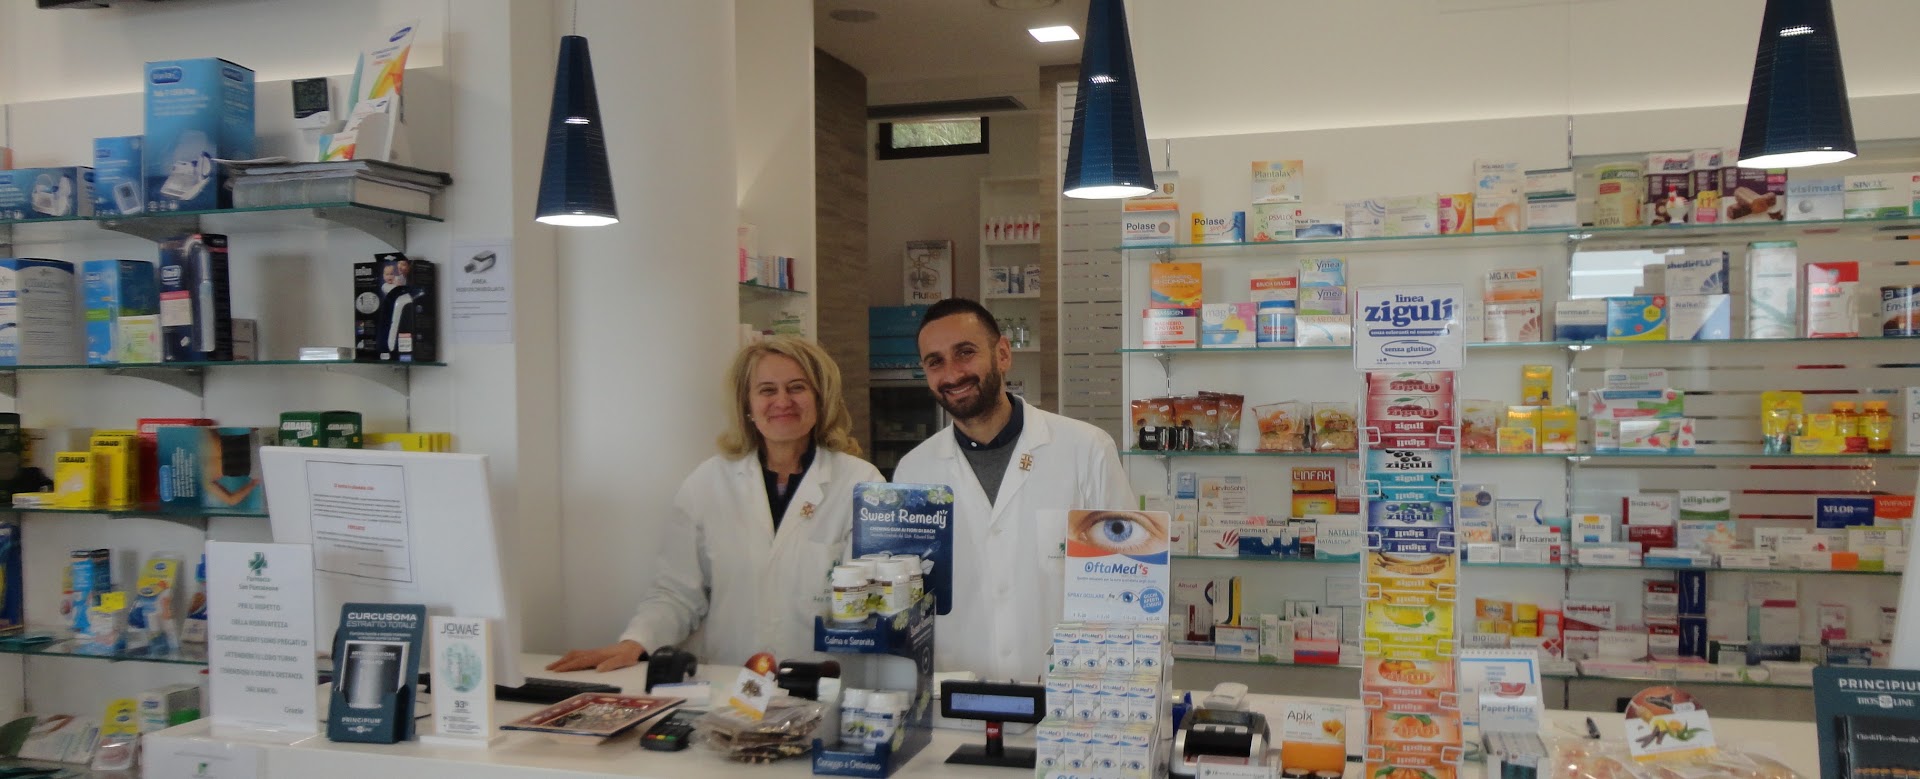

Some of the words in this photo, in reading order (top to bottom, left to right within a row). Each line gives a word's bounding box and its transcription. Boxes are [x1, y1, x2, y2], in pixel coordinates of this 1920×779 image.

[1126, 222, 1156, 232] Polase
[1194, 217, 1225, 227] Polase
[1395, 294, 1424, 303] linea
[1406, 344, 1433, 353] glutine
[282, 421, 313, 431] GIBAUD
[1292, 470, 1333, 482] LINFAX
[860, 507, 896, 522] Sweet
[898, 508, 949, 529] Remedy
[1328, 529, 1361, 537] NATALBE
[348, 612, 418, 622] CURCUSOMA
[346, 620, 387, 629] ESTRATTO
[388, 621, 417, 629] TOTALE
[1287, 710, 1314, 722] Apix
